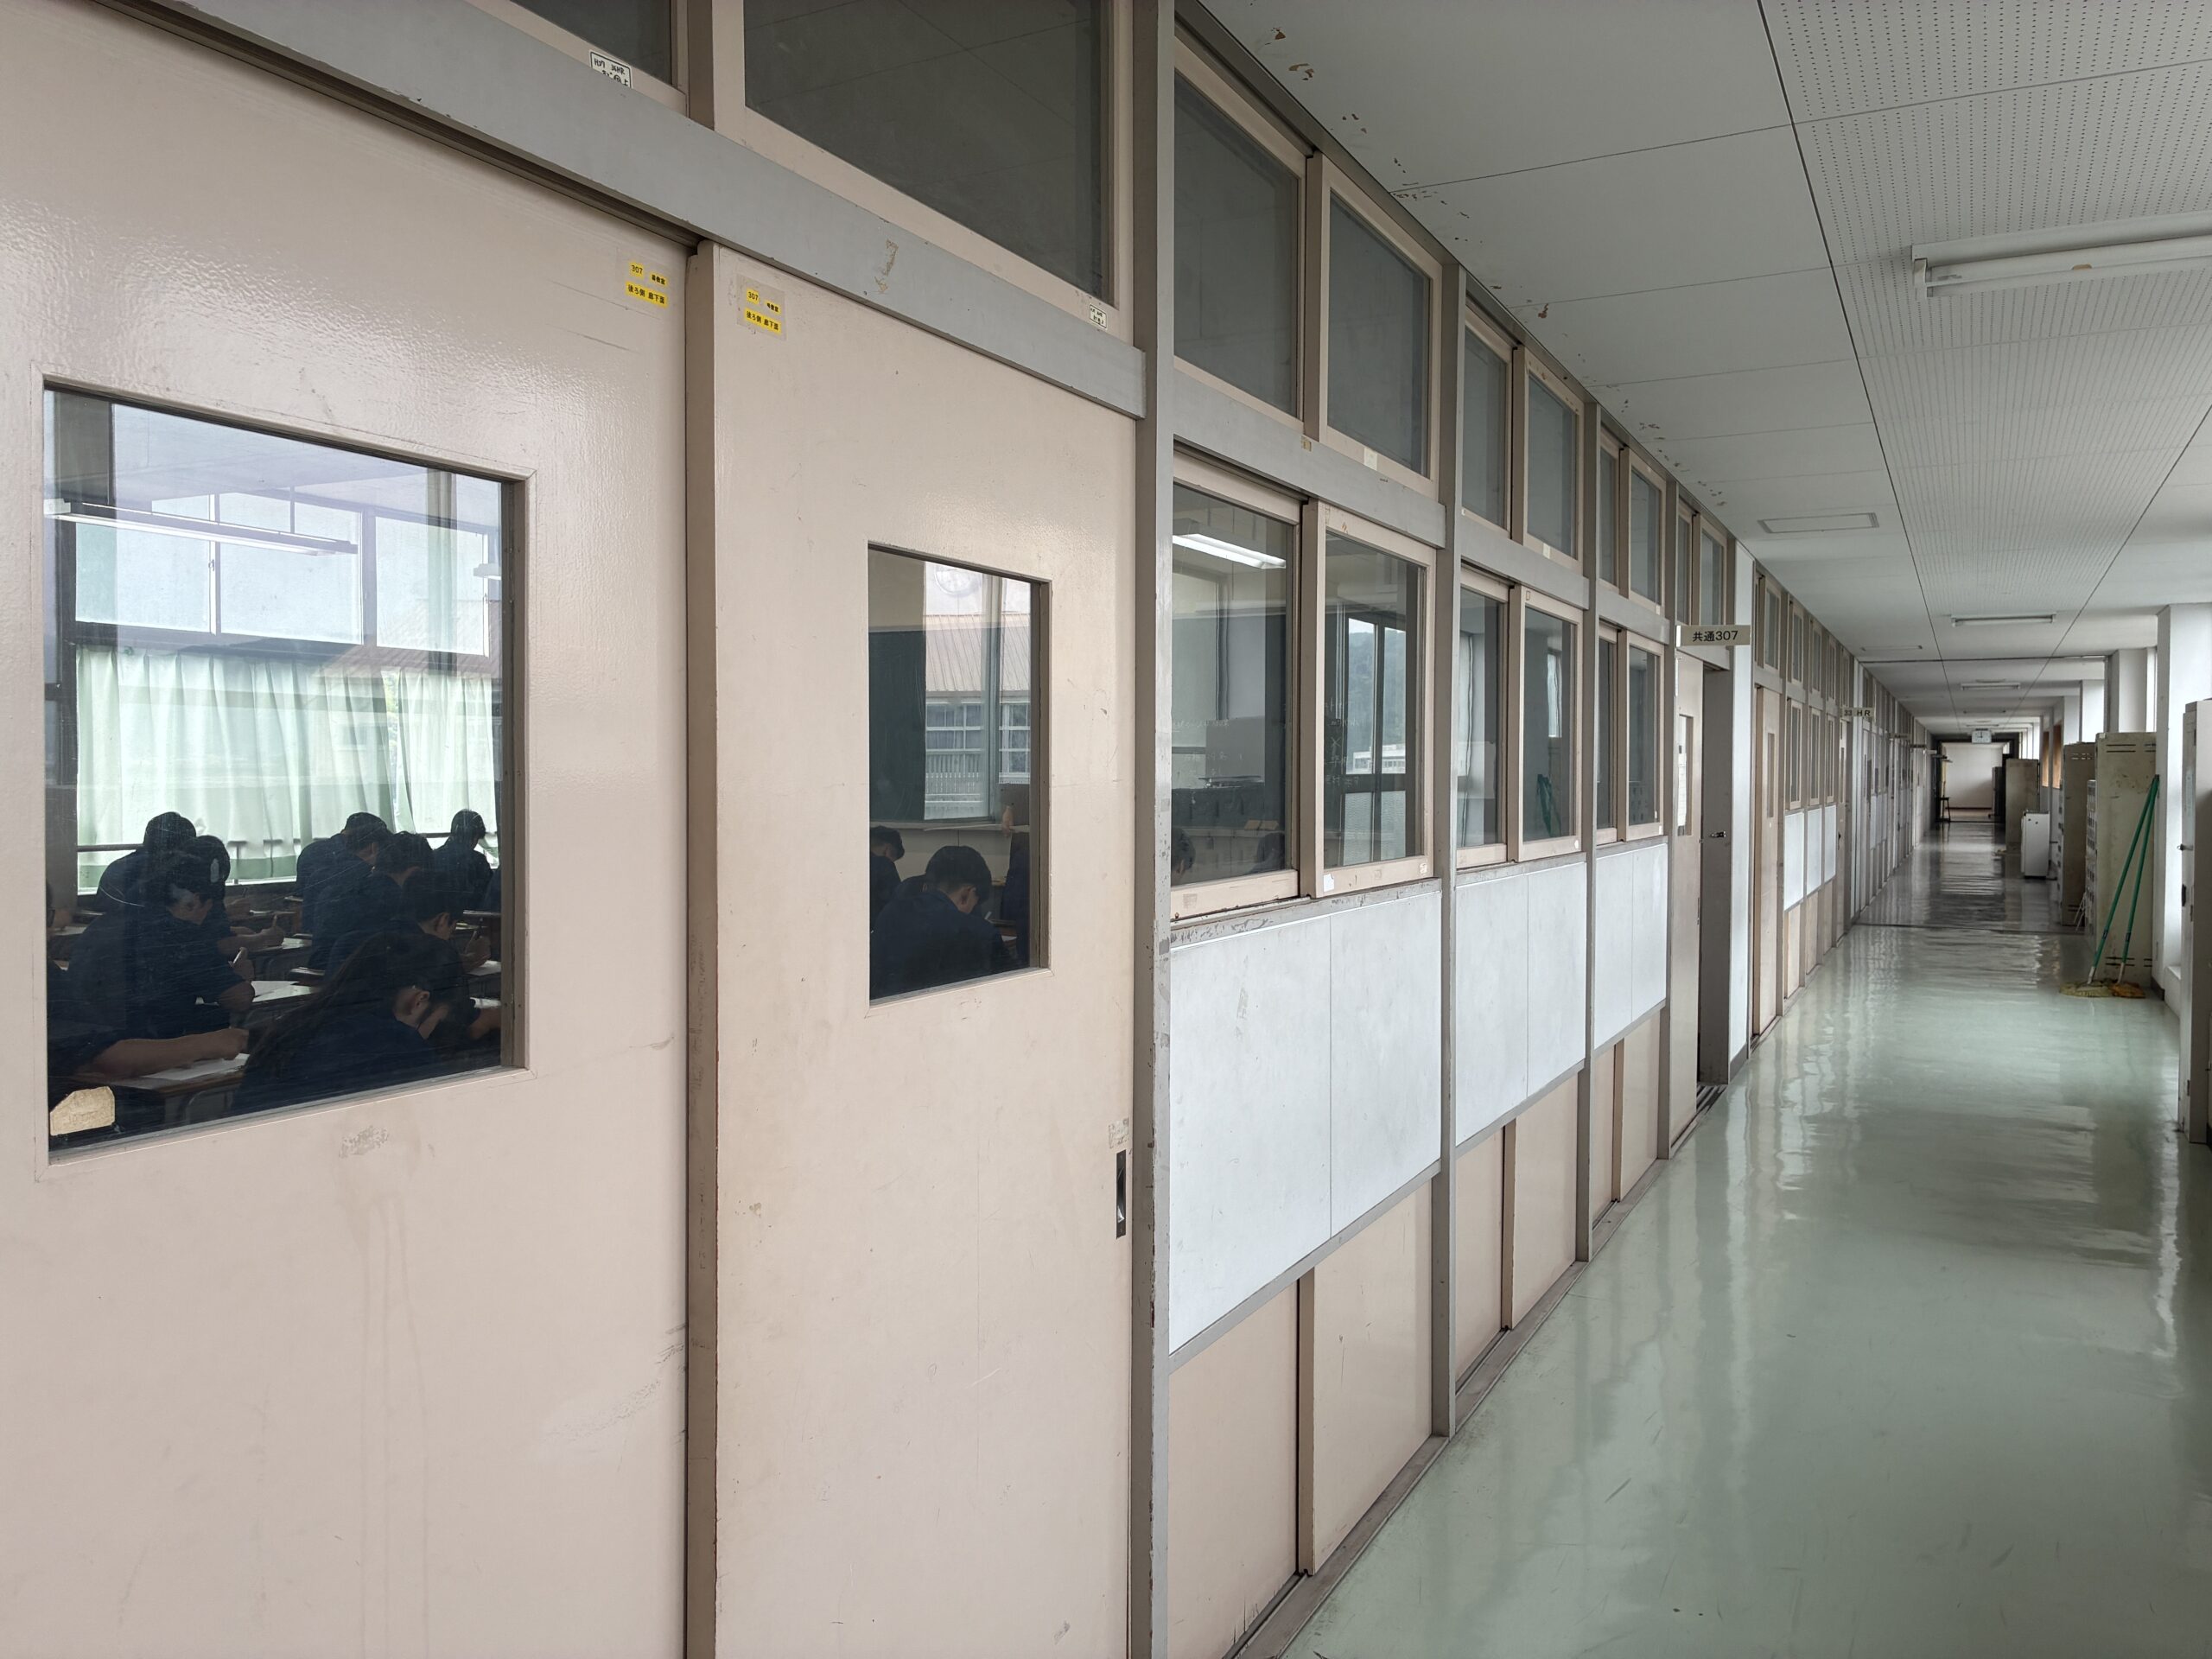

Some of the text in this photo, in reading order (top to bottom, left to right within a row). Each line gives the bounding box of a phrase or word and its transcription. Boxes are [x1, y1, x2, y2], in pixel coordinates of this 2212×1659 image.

[631, 264, 643, 274] 307
[748, 291, 759, 301] 307
[1693, 630, 1738, 642] 共通307
